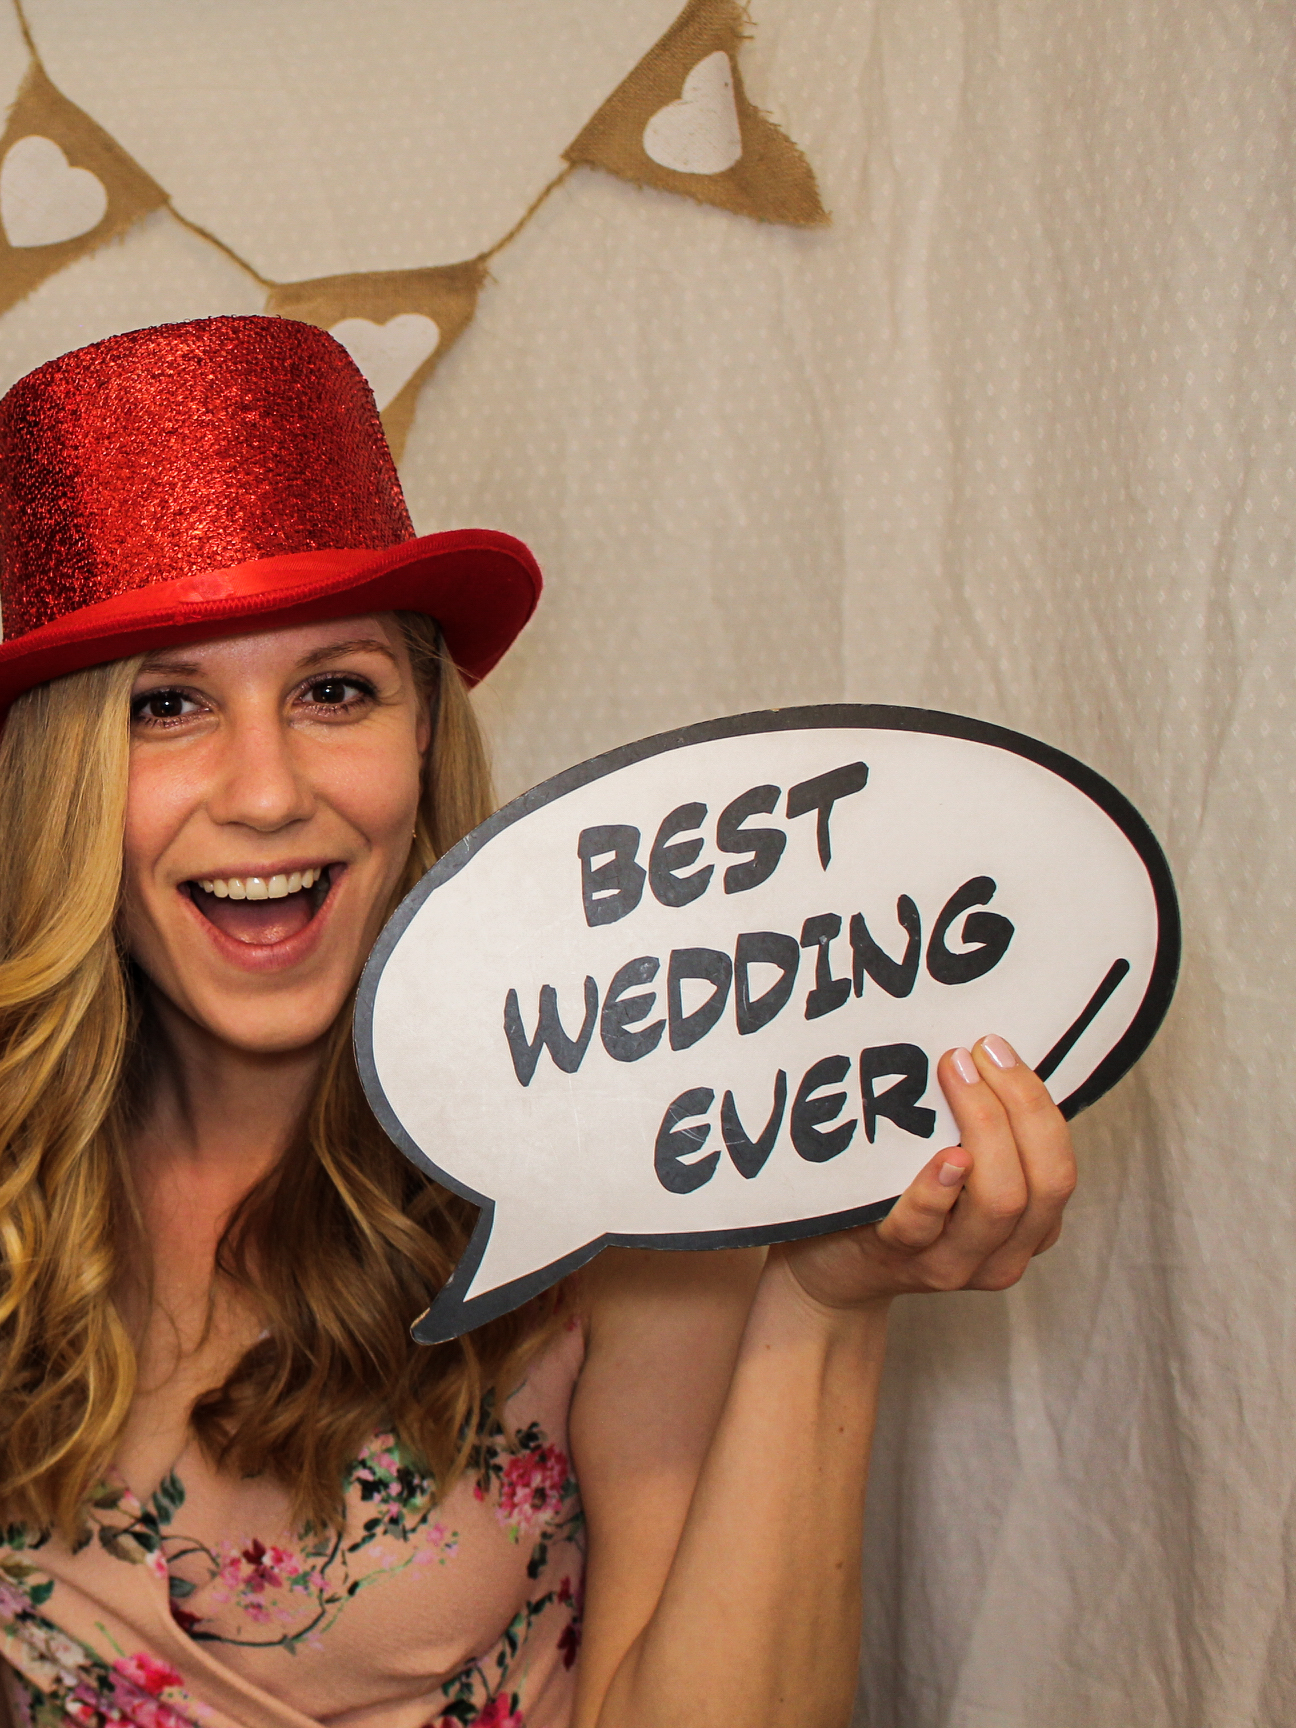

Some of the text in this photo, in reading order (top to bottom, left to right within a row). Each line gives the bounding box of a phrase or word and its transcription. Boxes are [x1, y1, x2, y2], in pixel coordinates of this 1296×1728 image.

[577, 761, 869, 927] BEST
[504, 876, 1015, 1087] WEDDING
[654, 1043, 937, 1195] EVER
